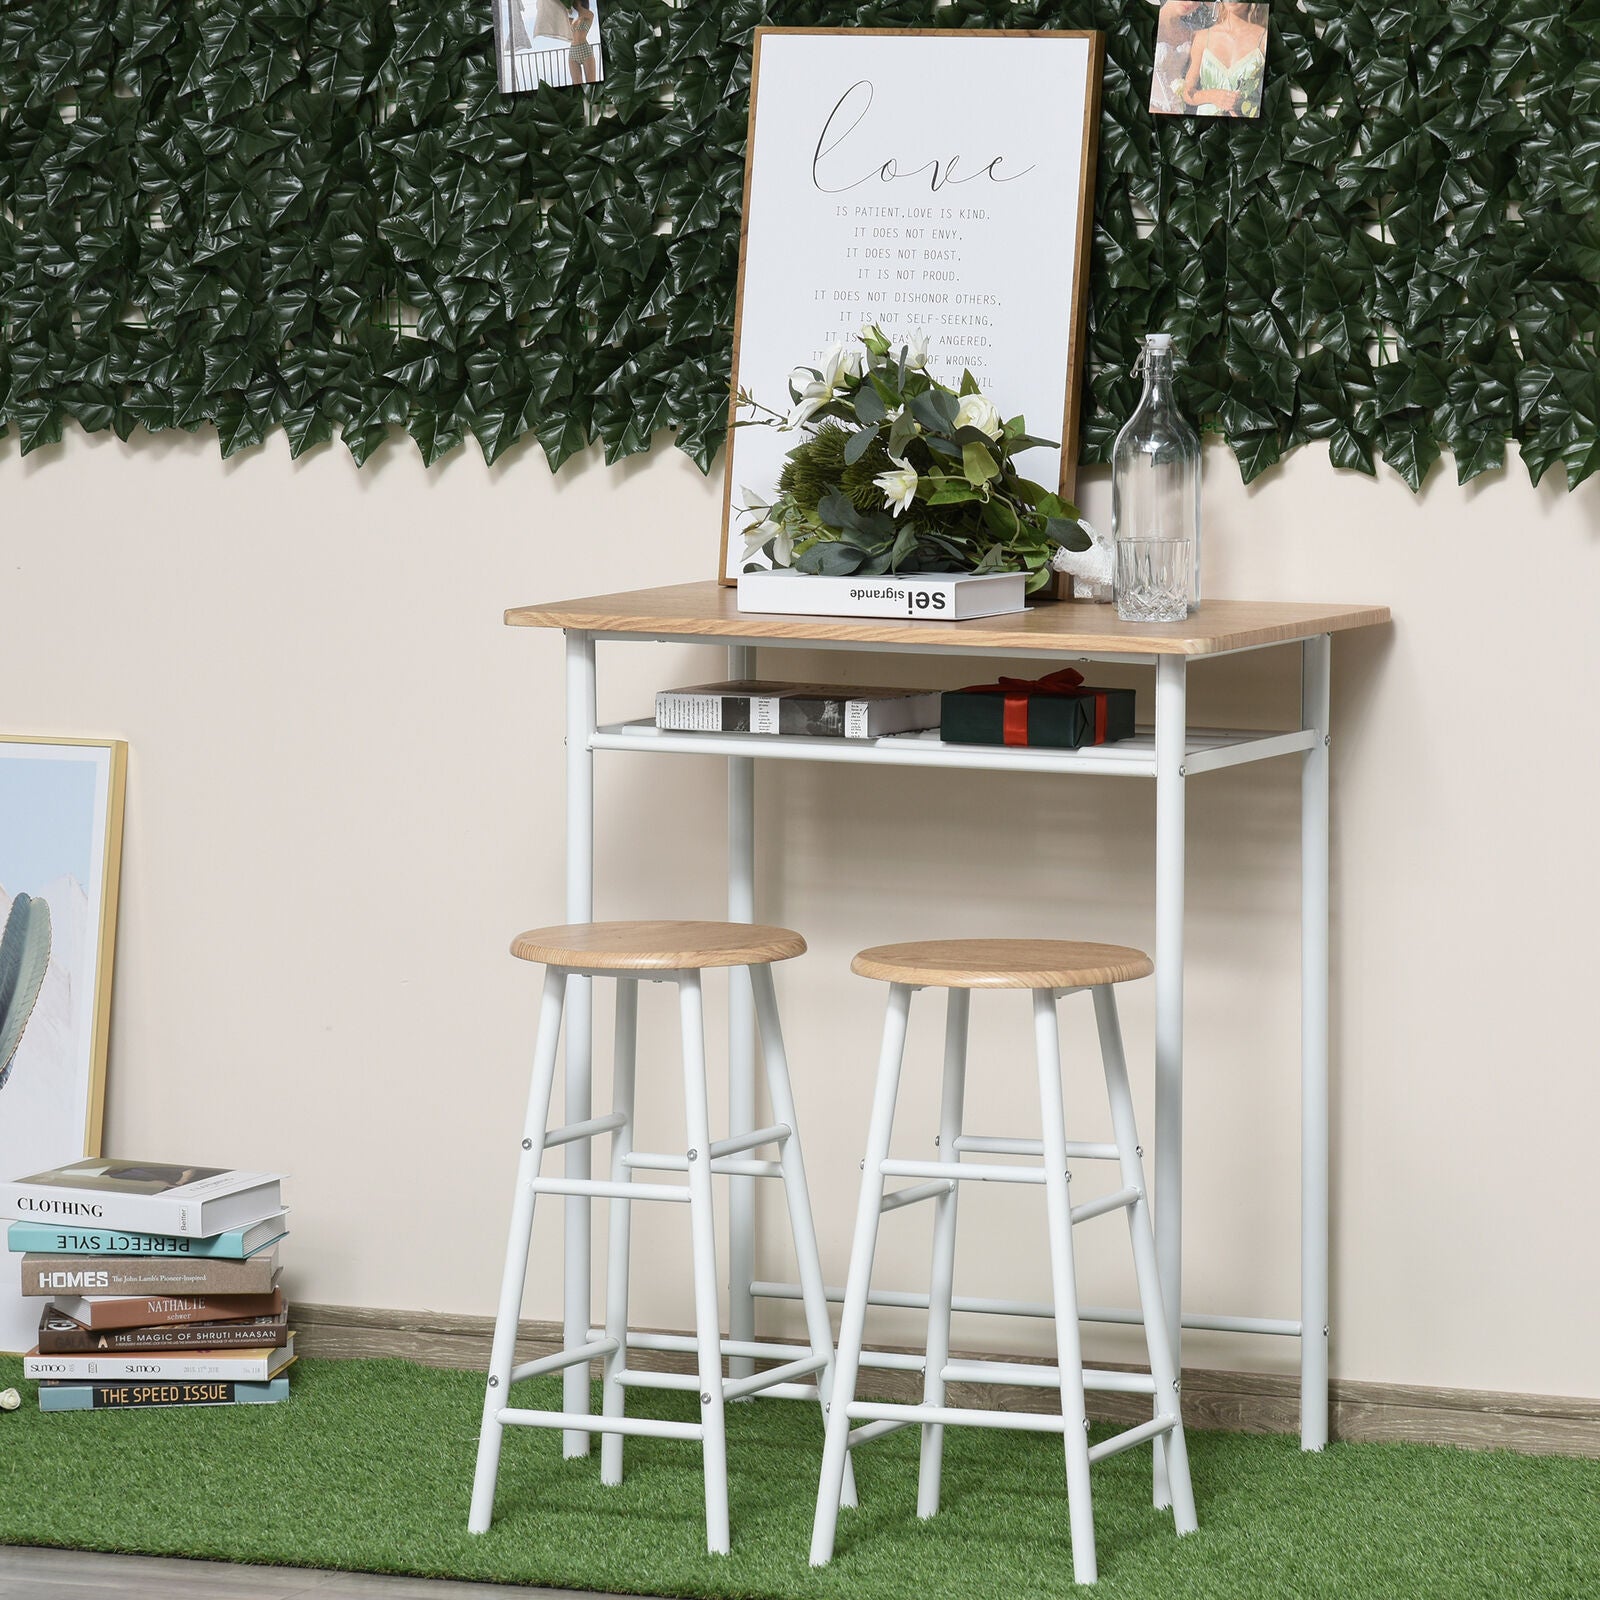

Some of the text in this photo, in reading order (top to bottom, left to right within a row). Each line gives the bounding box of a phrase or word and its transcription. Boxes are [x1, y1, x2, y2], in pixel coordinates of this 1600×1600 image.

[813, 79, 1038, 193] love
[836, 206, 848, 217] IS
[940, 208, 953, 219] IS
[959, 208, 990, 221] KIND.
[854, 227, 866, 238] IT
[873, 227, 899, 239] DOES
[905, 227, 925, 239] NOT
[846, 247, 859, 258] IT
[865, 247, 891, 259] DOES
[898, 248, 917, 260] NOT
[858, 268, 960, 282] IT IS NOT PROUD.
[814, 289, 827, 300] IT
[833, 289, 860, 302] DOES
[867, 290, 888, 303] NOT
[894, 291, 949, 305] DISHONOR
[839, 311, 852, 322] IT
[860, 311, 873, 323] IS
[879, 312, 899, 324] NOT
[824, 332, 837, 343] IT
[812, 350, 988, 367] IT OF WRONGS.
[850, 588, 946, 615] sei sigrande
[17, 1197, 104, 1218] CLOTHING
[57, 1234, 190, 1252] PERFECT SYLE
[39, 1271, 108, 1288] HOMES
[123, 1275, 137, 1284] John
[147, 1297, 206, 1314] NATHALIE
[136, 1333, 172, 1341] MAGIC
[177, 1332, 192, 1340] OF
[196, 1331, 231, 1340] SHRUTI
[235, 1330, 277, 1338] HAASAN
[101, 1385, 227, 1403] THE SPEED ISSUE
